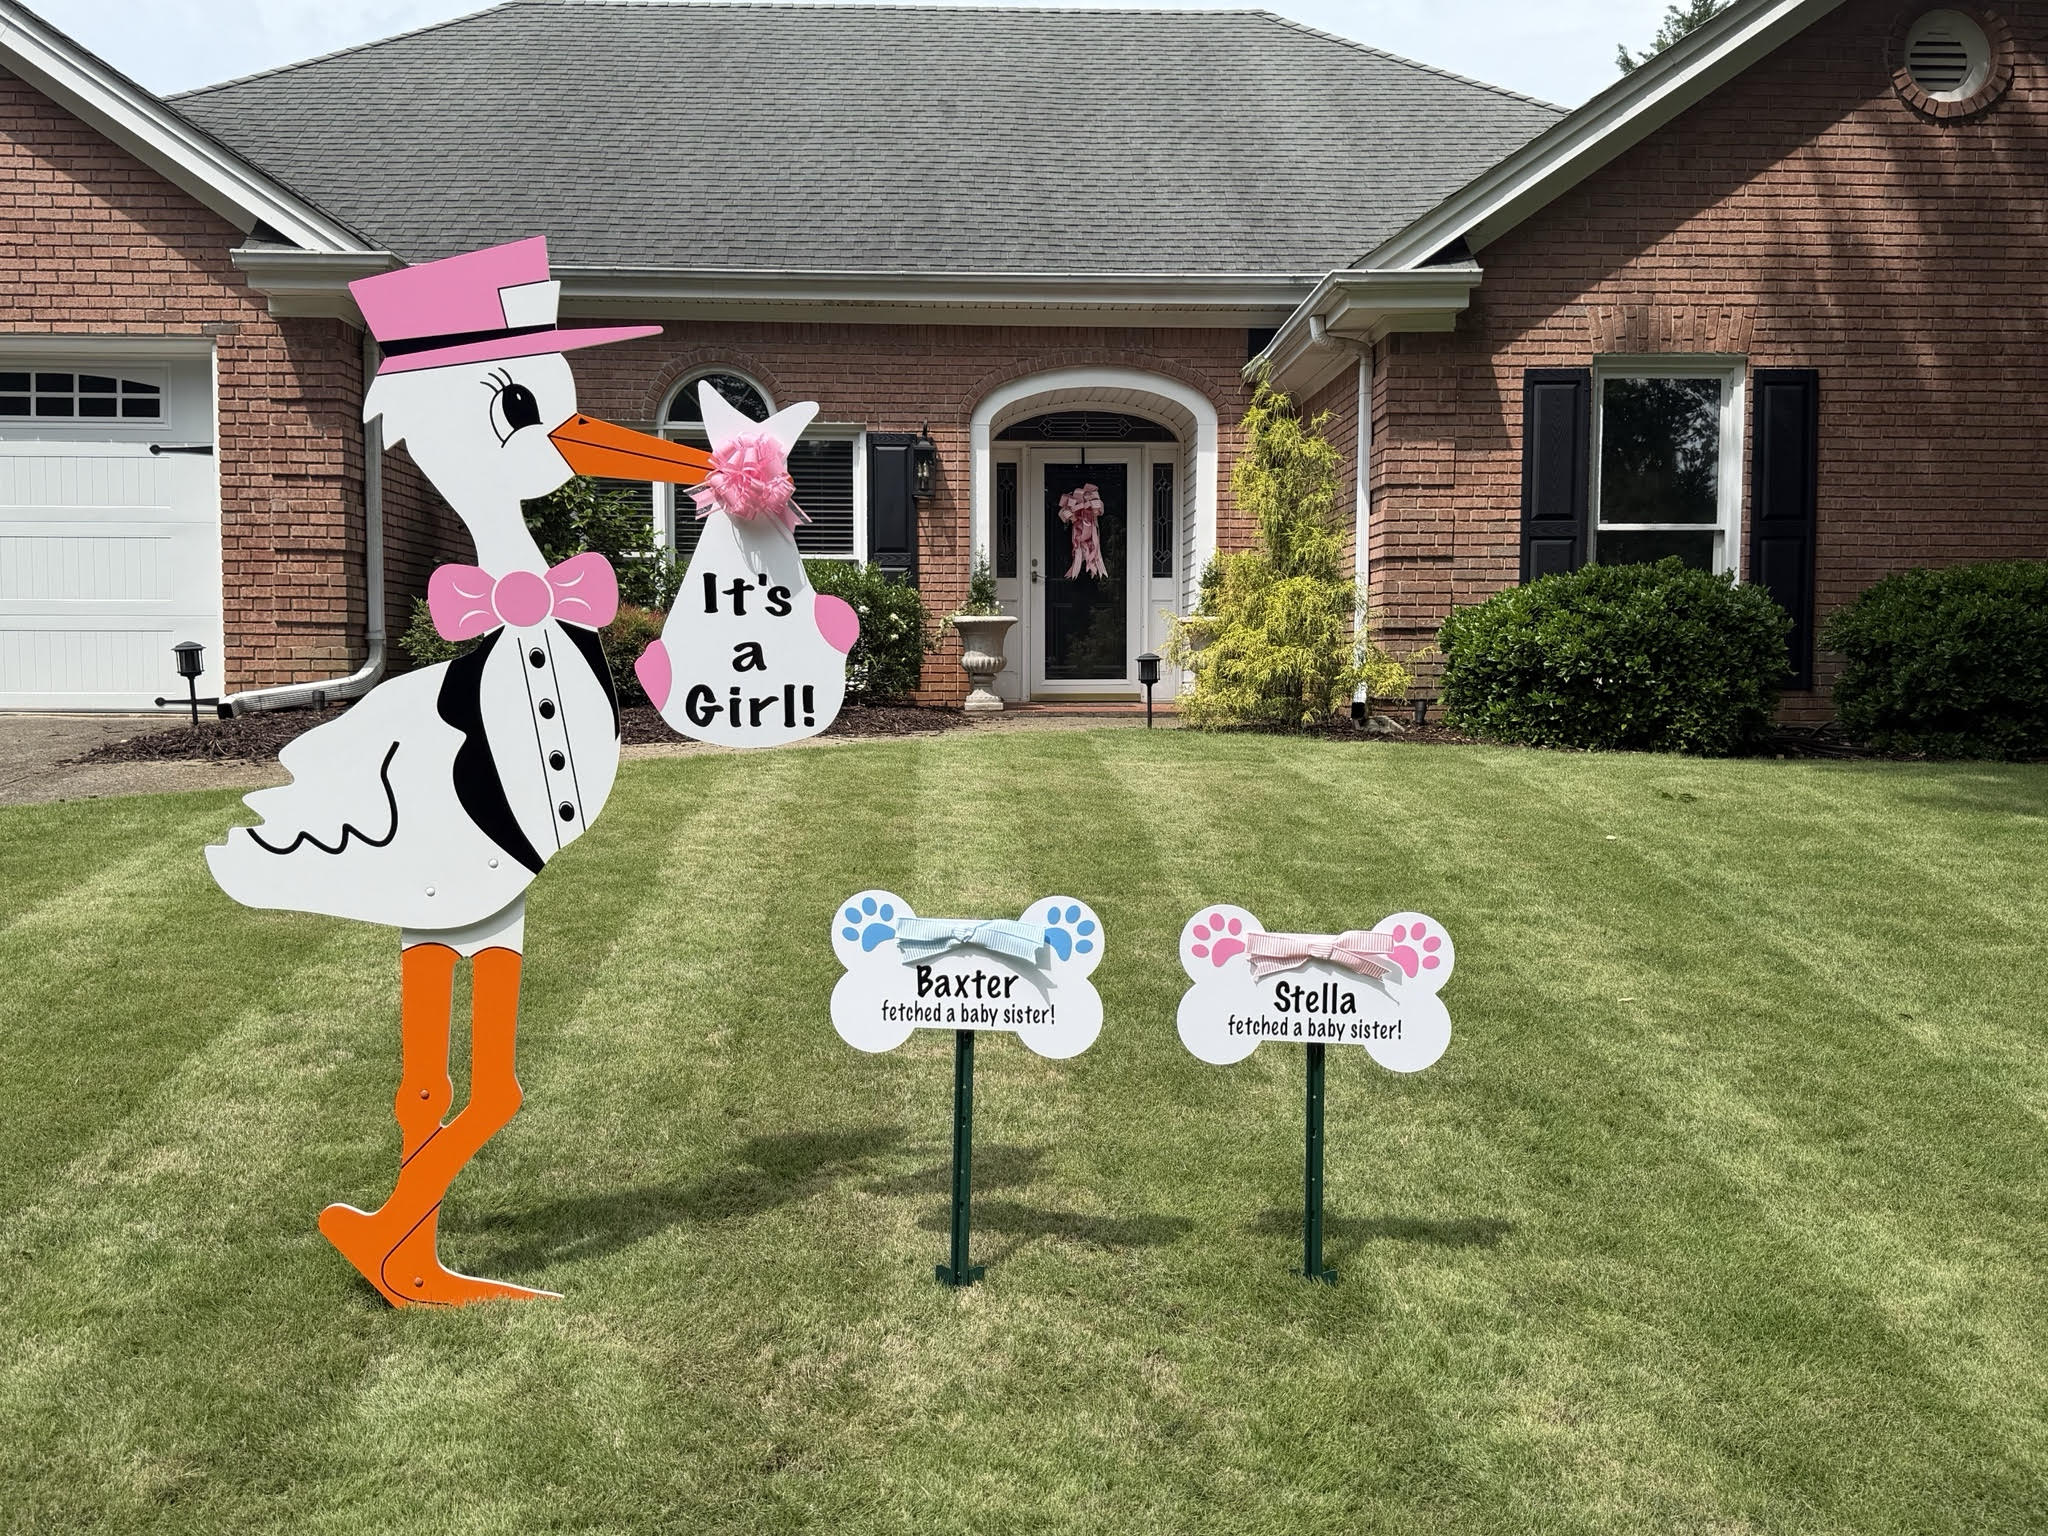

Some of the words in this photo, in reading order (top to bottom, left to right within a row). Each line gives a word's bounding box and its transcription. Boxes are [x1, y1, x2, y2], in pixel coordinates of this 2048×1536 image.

[703, 573, 792, 616] It's
[732, 641, 767, 672] a
[685, 684, 815, 727] Girl!
[917, 965, 1019, 999] Baxter
[1274, 981, 1357, 1014] Stella
[882, 1000, 941, 1022] fetched
[947, 1007, 956, 1022] a
[961, 1003, 998, 1027] baby
[1003, 1004, 1055, 1024] sister!
[1228, 1014, 1288, 1036] fetched
[1293, 1021, 1303, 1036] a
[1308, 1017, 1346, 1041] baby
[1350, 1019, 1402, 1039] sister!
